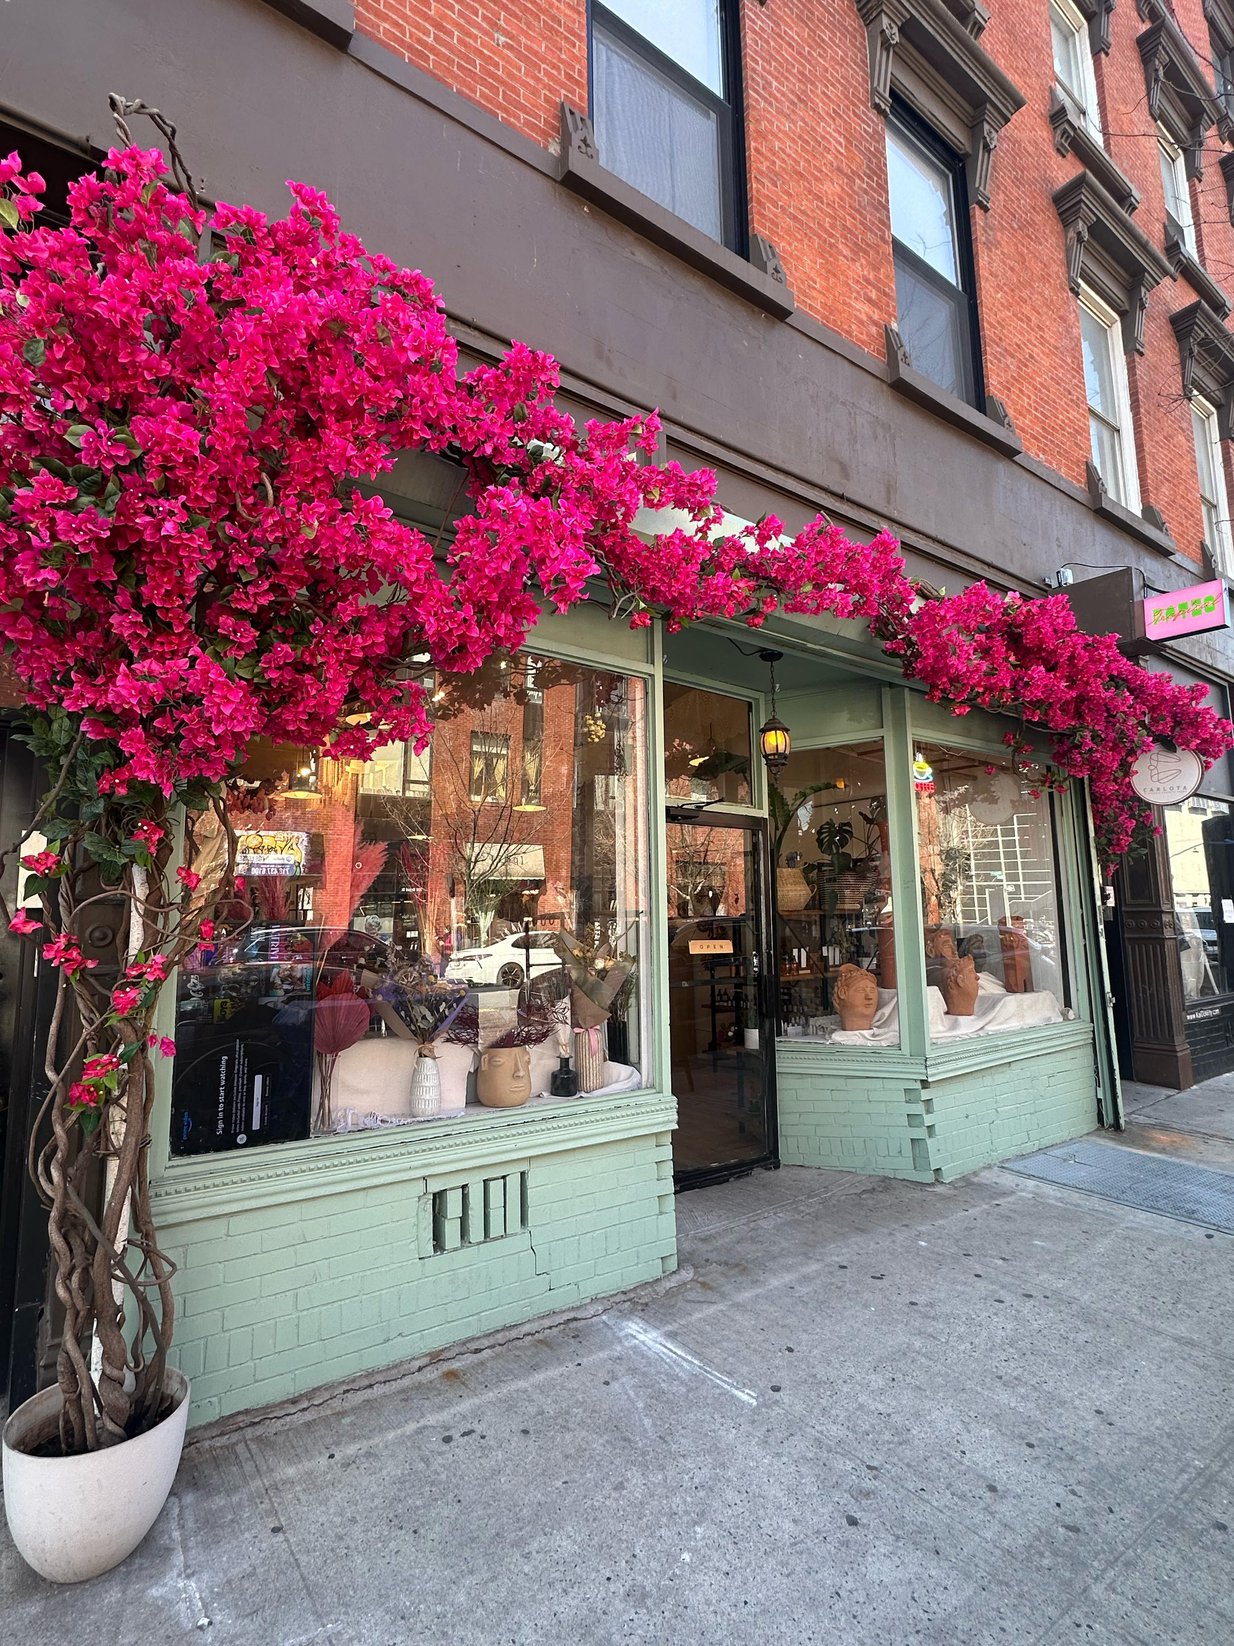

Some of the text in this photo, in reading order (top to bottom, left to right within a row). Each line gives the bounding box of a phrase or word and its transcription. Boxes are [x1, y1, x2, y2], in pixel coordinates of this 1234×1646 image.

[1143, 785, 1187, 793] CARLOTA
[219, 1055, 228, 1085] watching
[218, 1103, 224, 1111] to
[216, 1119, 225, 1135] Sign
